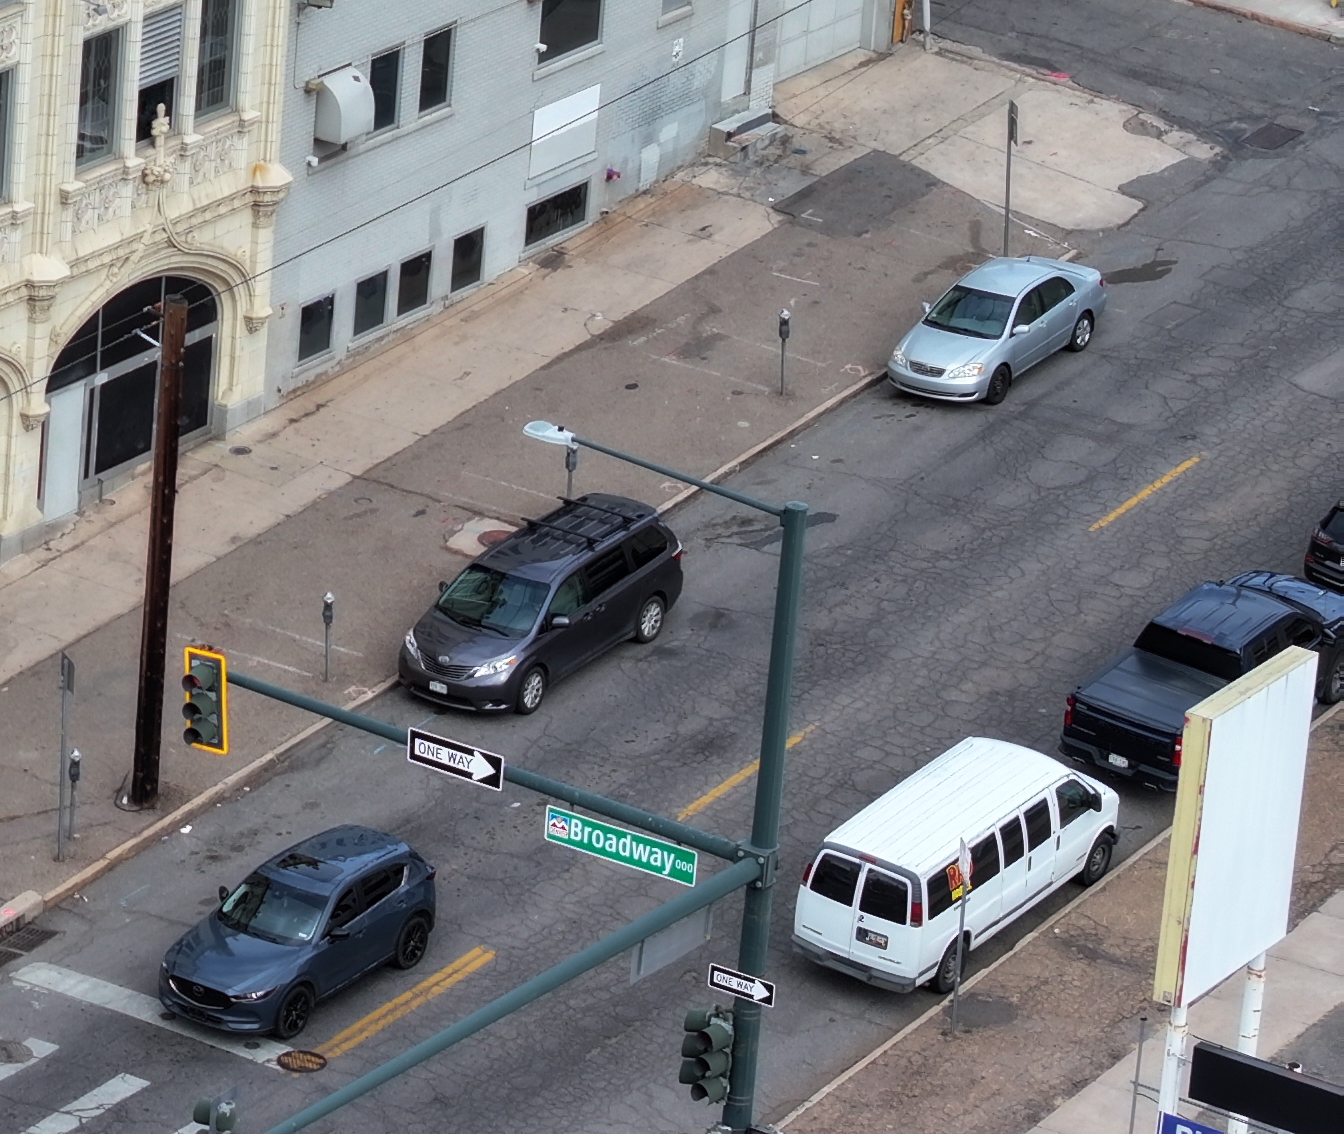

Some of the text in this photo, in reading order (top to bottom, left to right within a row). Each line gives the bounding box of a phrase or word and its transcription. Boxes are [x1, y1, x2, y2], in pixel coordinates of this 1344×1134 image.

[418, 741, 473, 770] ONE WAY
[569, 818, 693, 875] Broadway 000
[716, 973, 754, 993] ONE WAY
